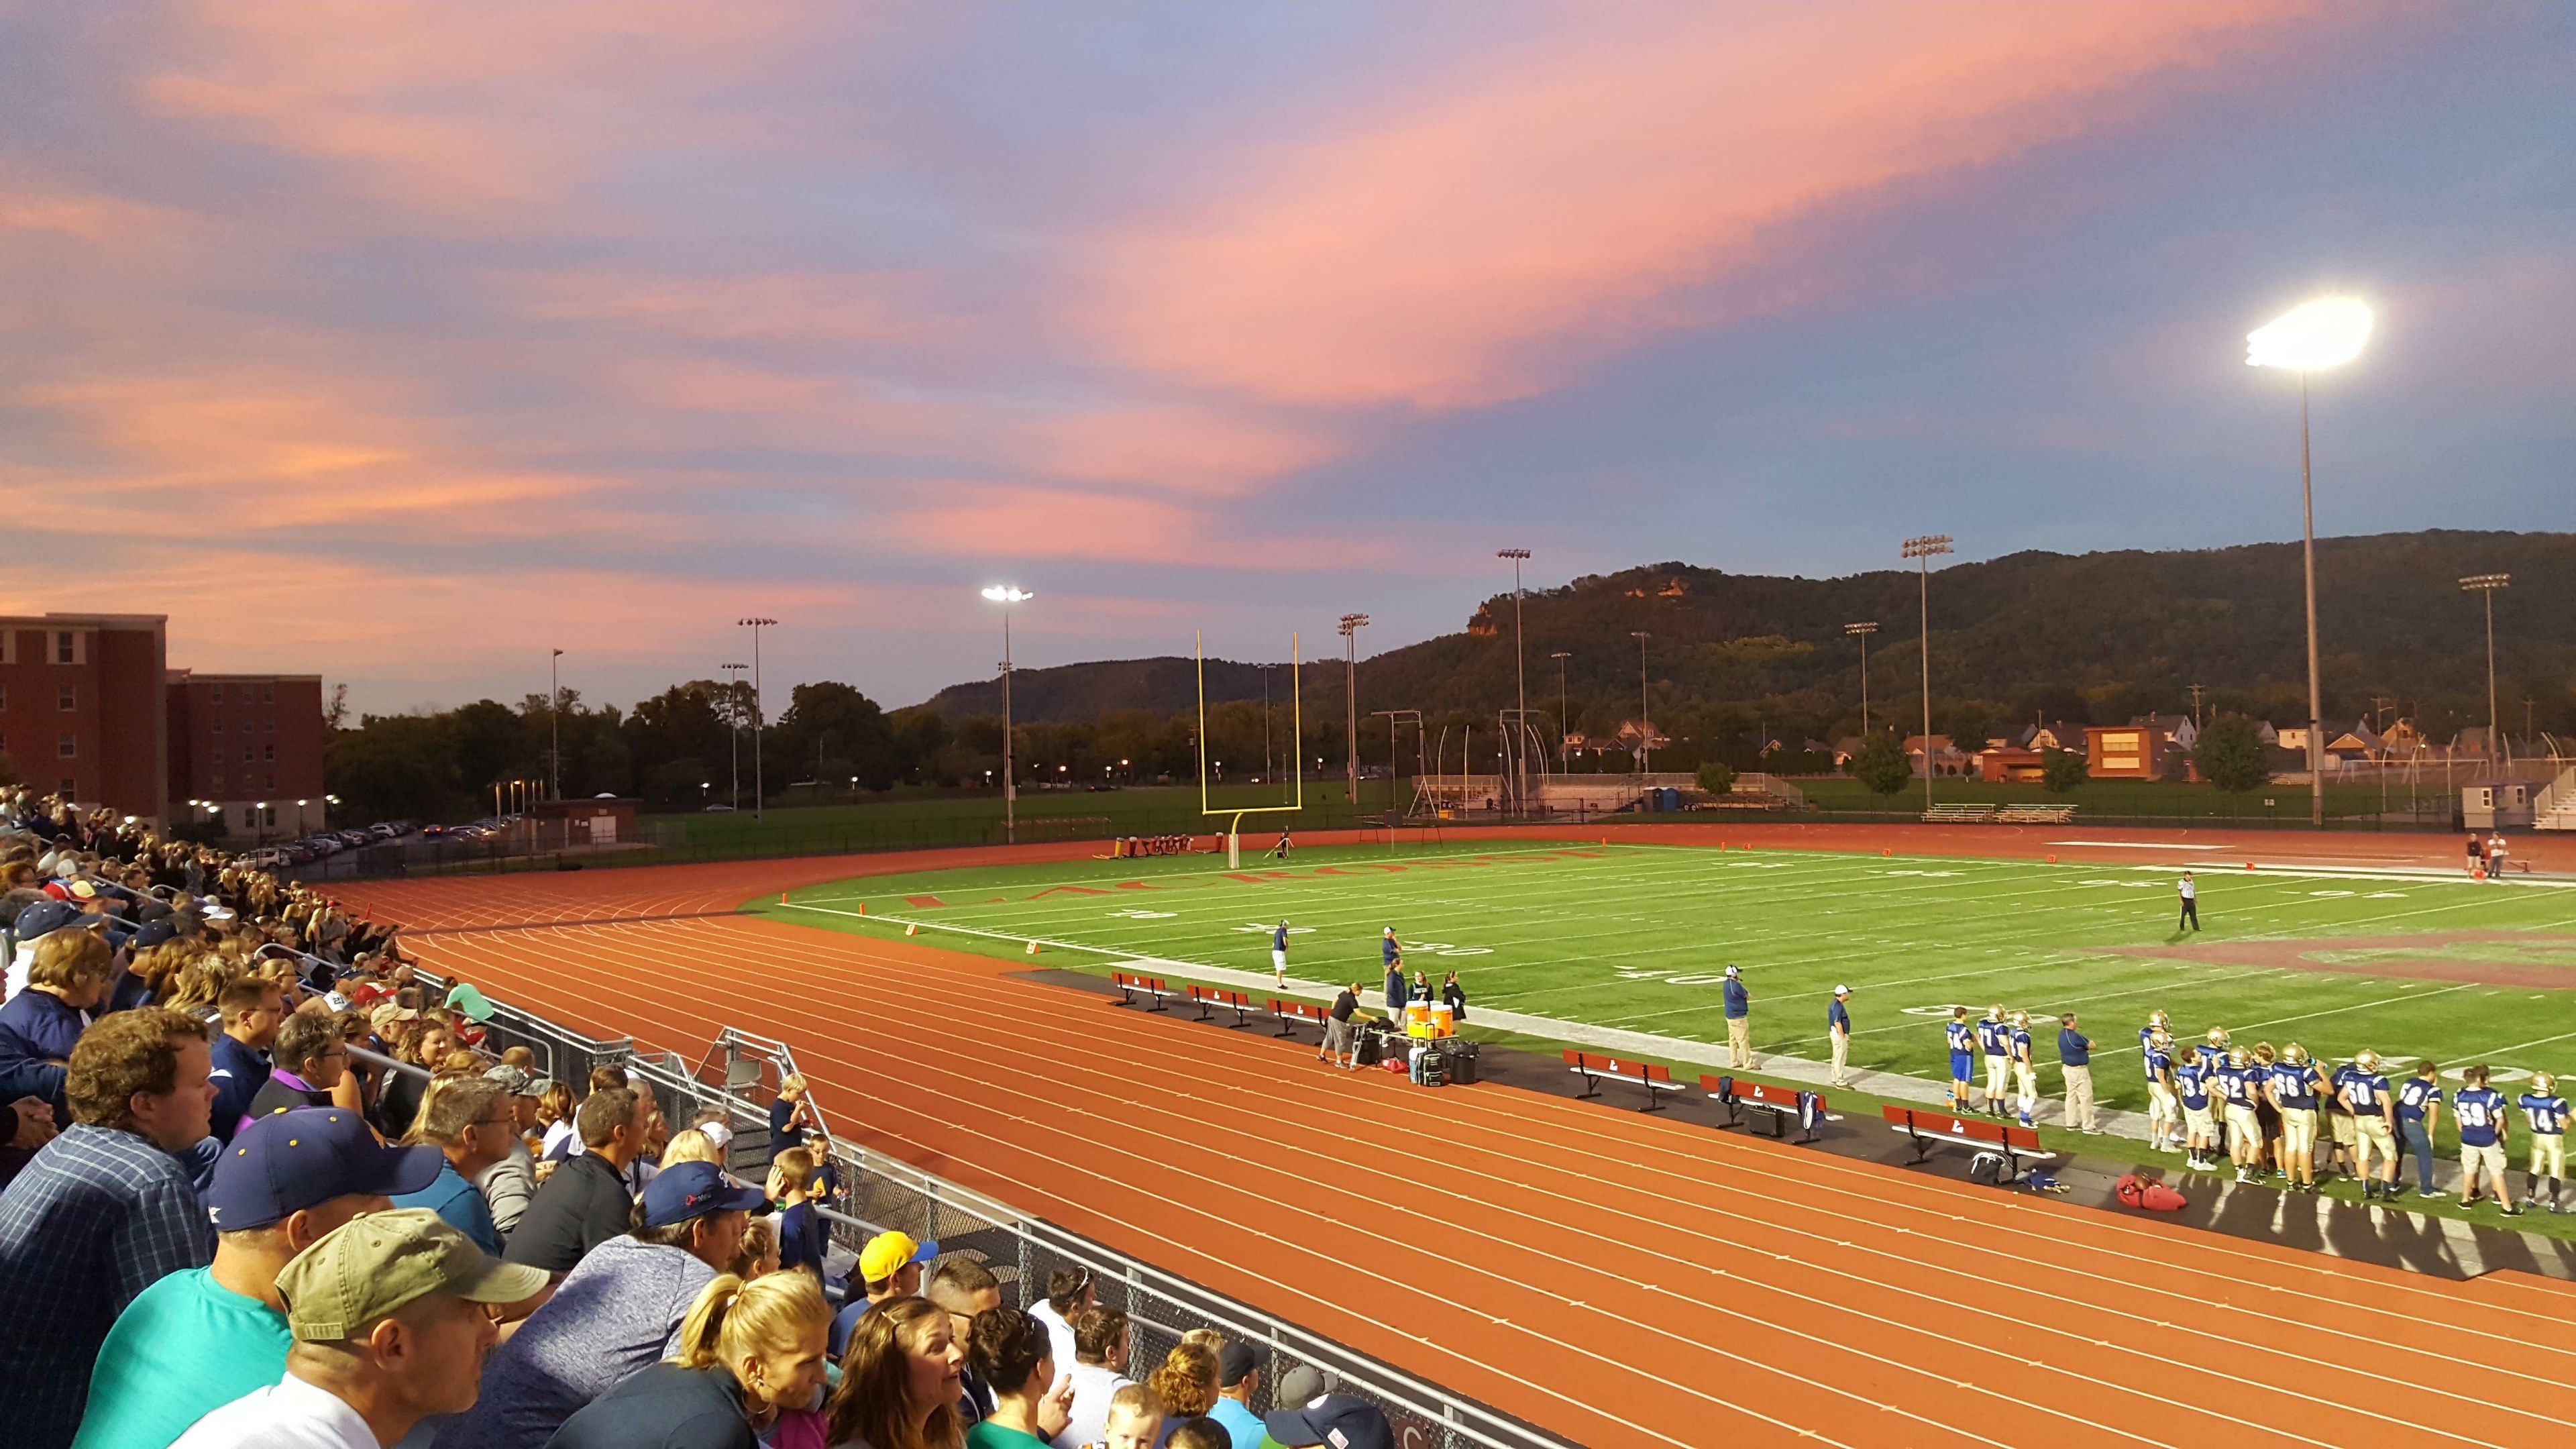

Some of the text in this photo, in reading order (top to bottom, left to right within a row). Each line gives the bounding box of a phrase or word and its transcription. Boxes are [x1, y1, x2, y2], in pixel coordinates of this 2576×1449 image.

[2218, 1074, 2243, 1098] 52
[2345, 1081, 2371, 1106] 50
[2457, 1102, 2487, 1127] 59
[2526, 1107, 2553, 1132] 14
